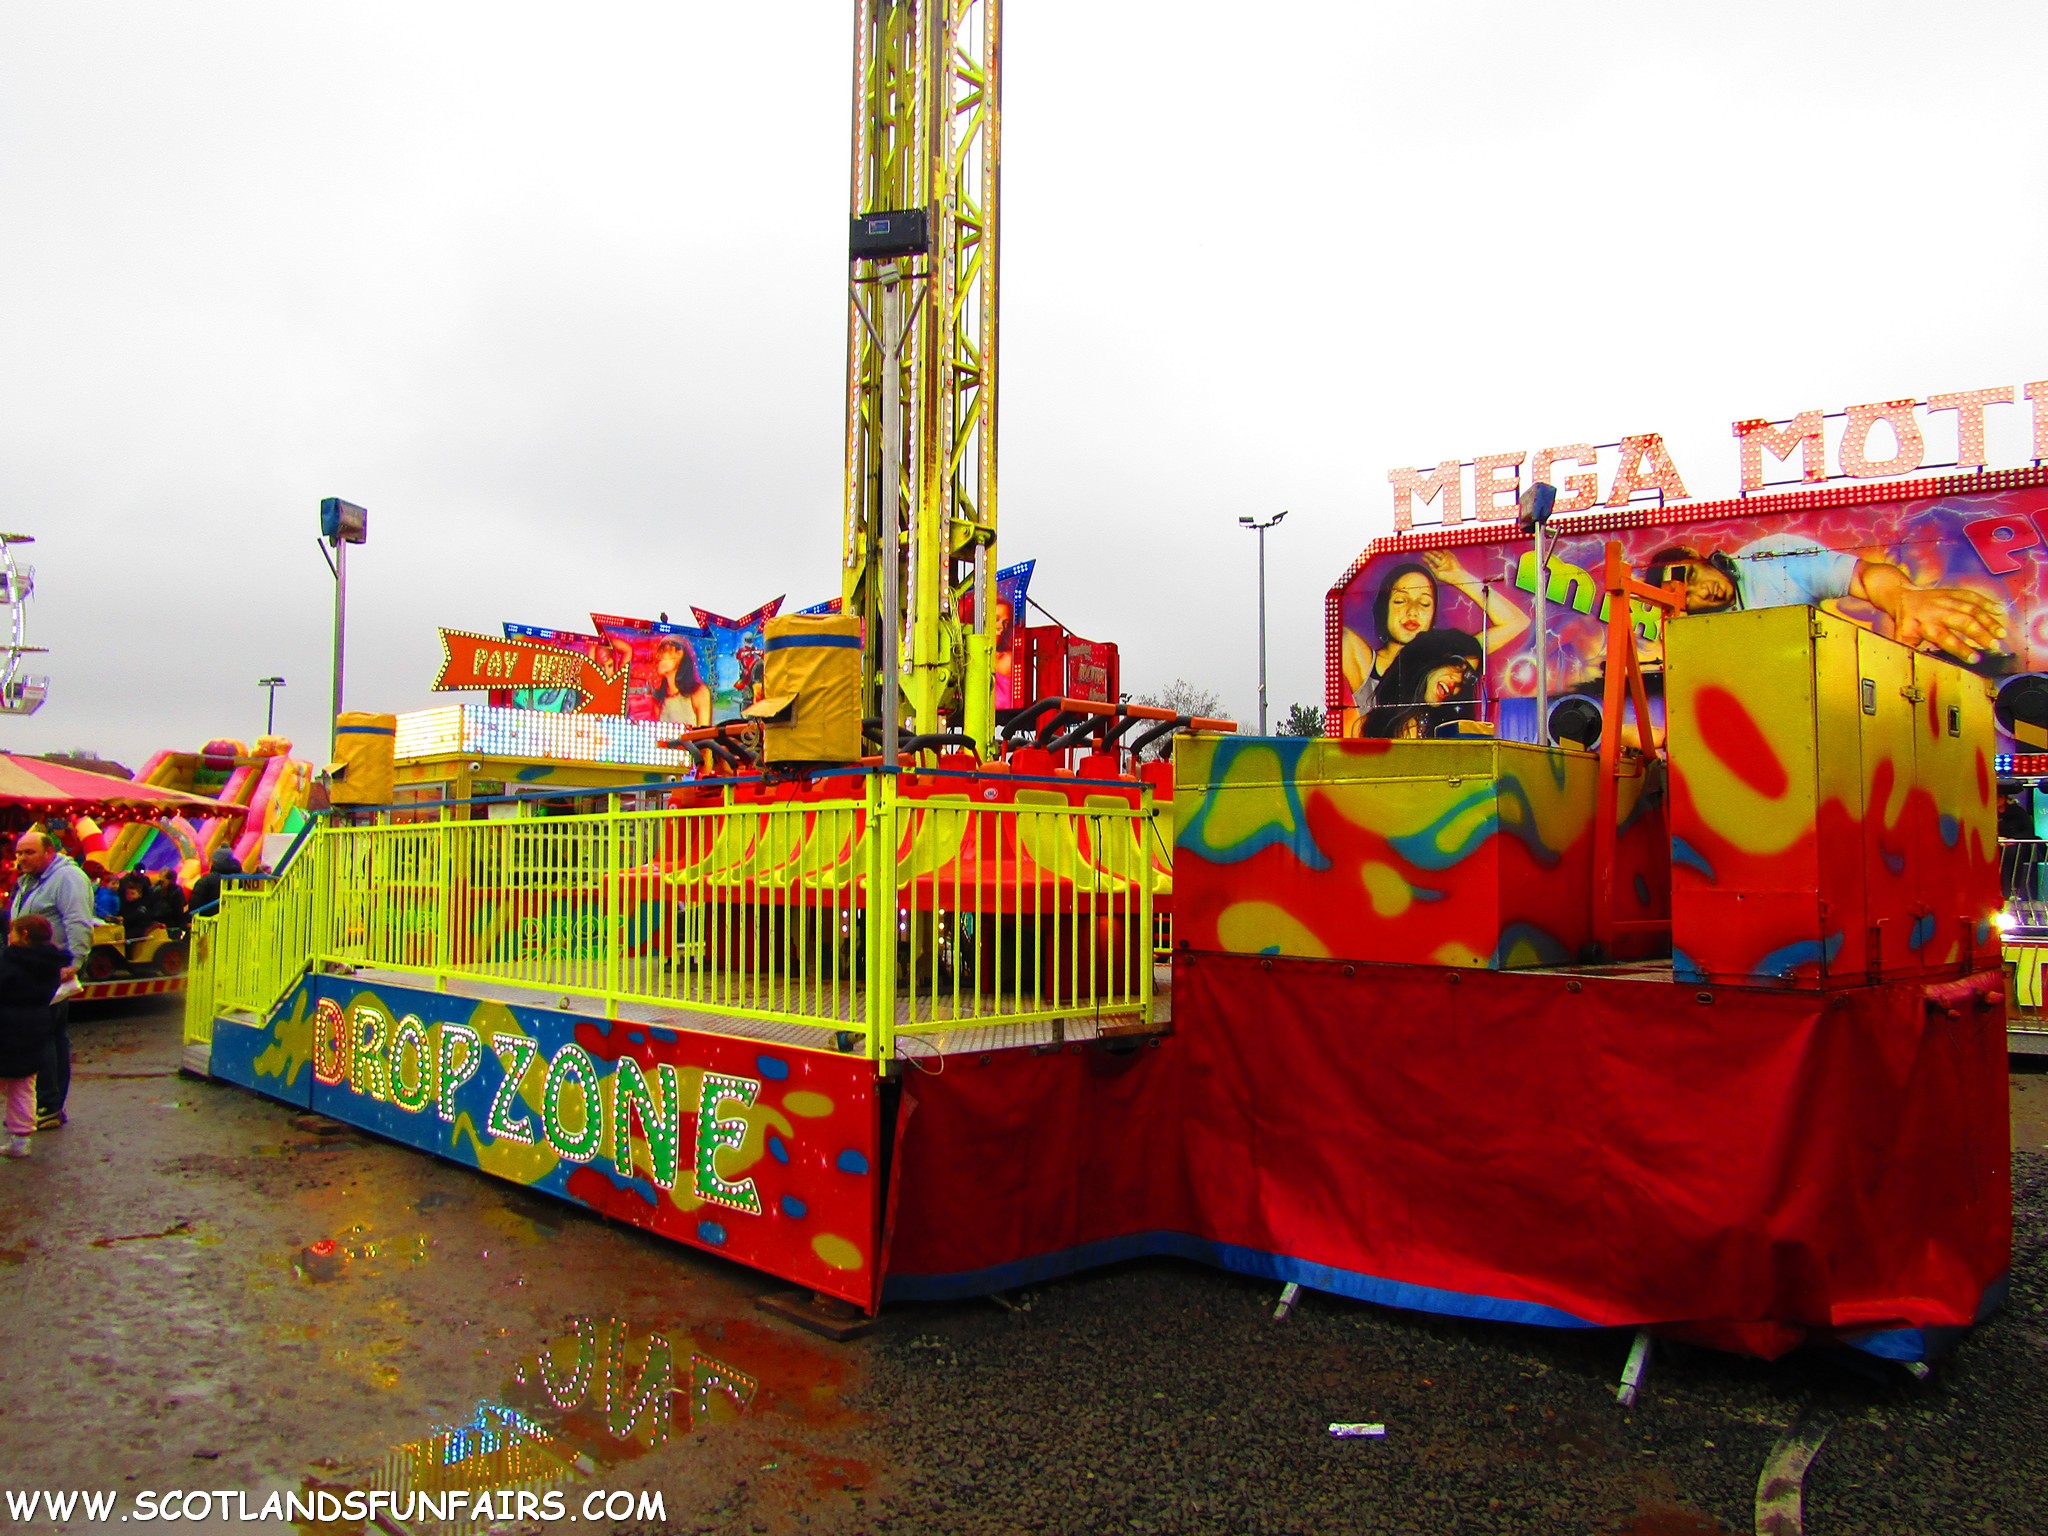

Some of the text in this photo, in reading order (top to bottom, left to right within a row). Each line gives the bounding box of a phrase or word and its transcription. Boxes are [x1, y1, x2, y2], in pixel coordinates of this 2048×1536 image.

[1388, 433, 1691, 532] MEGA
[473, 648, 583, 685] PAY HERE
